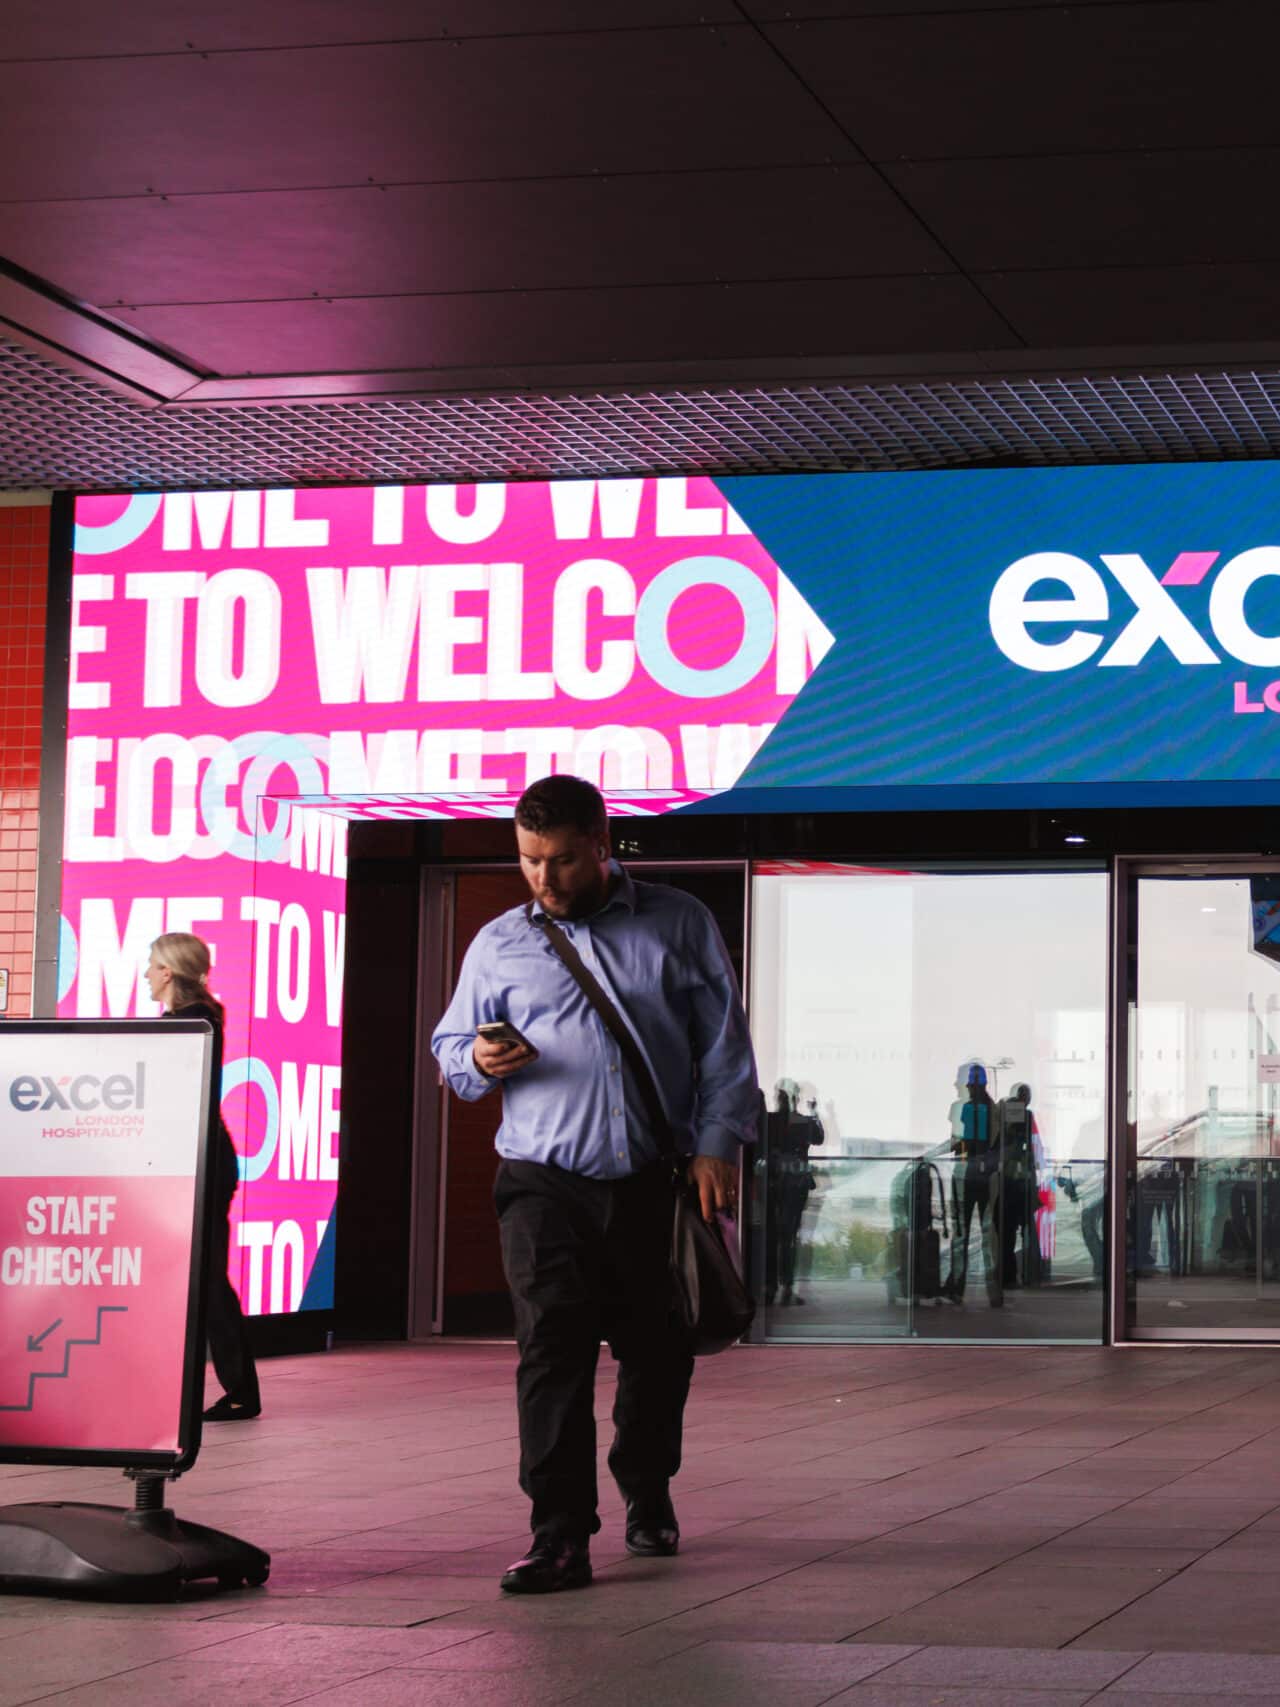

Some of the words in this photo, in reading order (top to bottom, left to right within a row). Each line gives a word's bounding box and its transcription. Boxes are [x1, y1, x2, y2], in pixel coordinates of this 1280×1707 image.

[125, 568, 282, 708] TO
[240, 896, 311, 1024] TO
[9, 1061, 145, 1112] excel
[42, 1128, 144, 1138] HOSPITALITY
[75, 1115, 144, 1126] LONDON
[26, 1195, 117, 1235] STAFF
[1, 1246, 142, 1286] CHECK-IN
